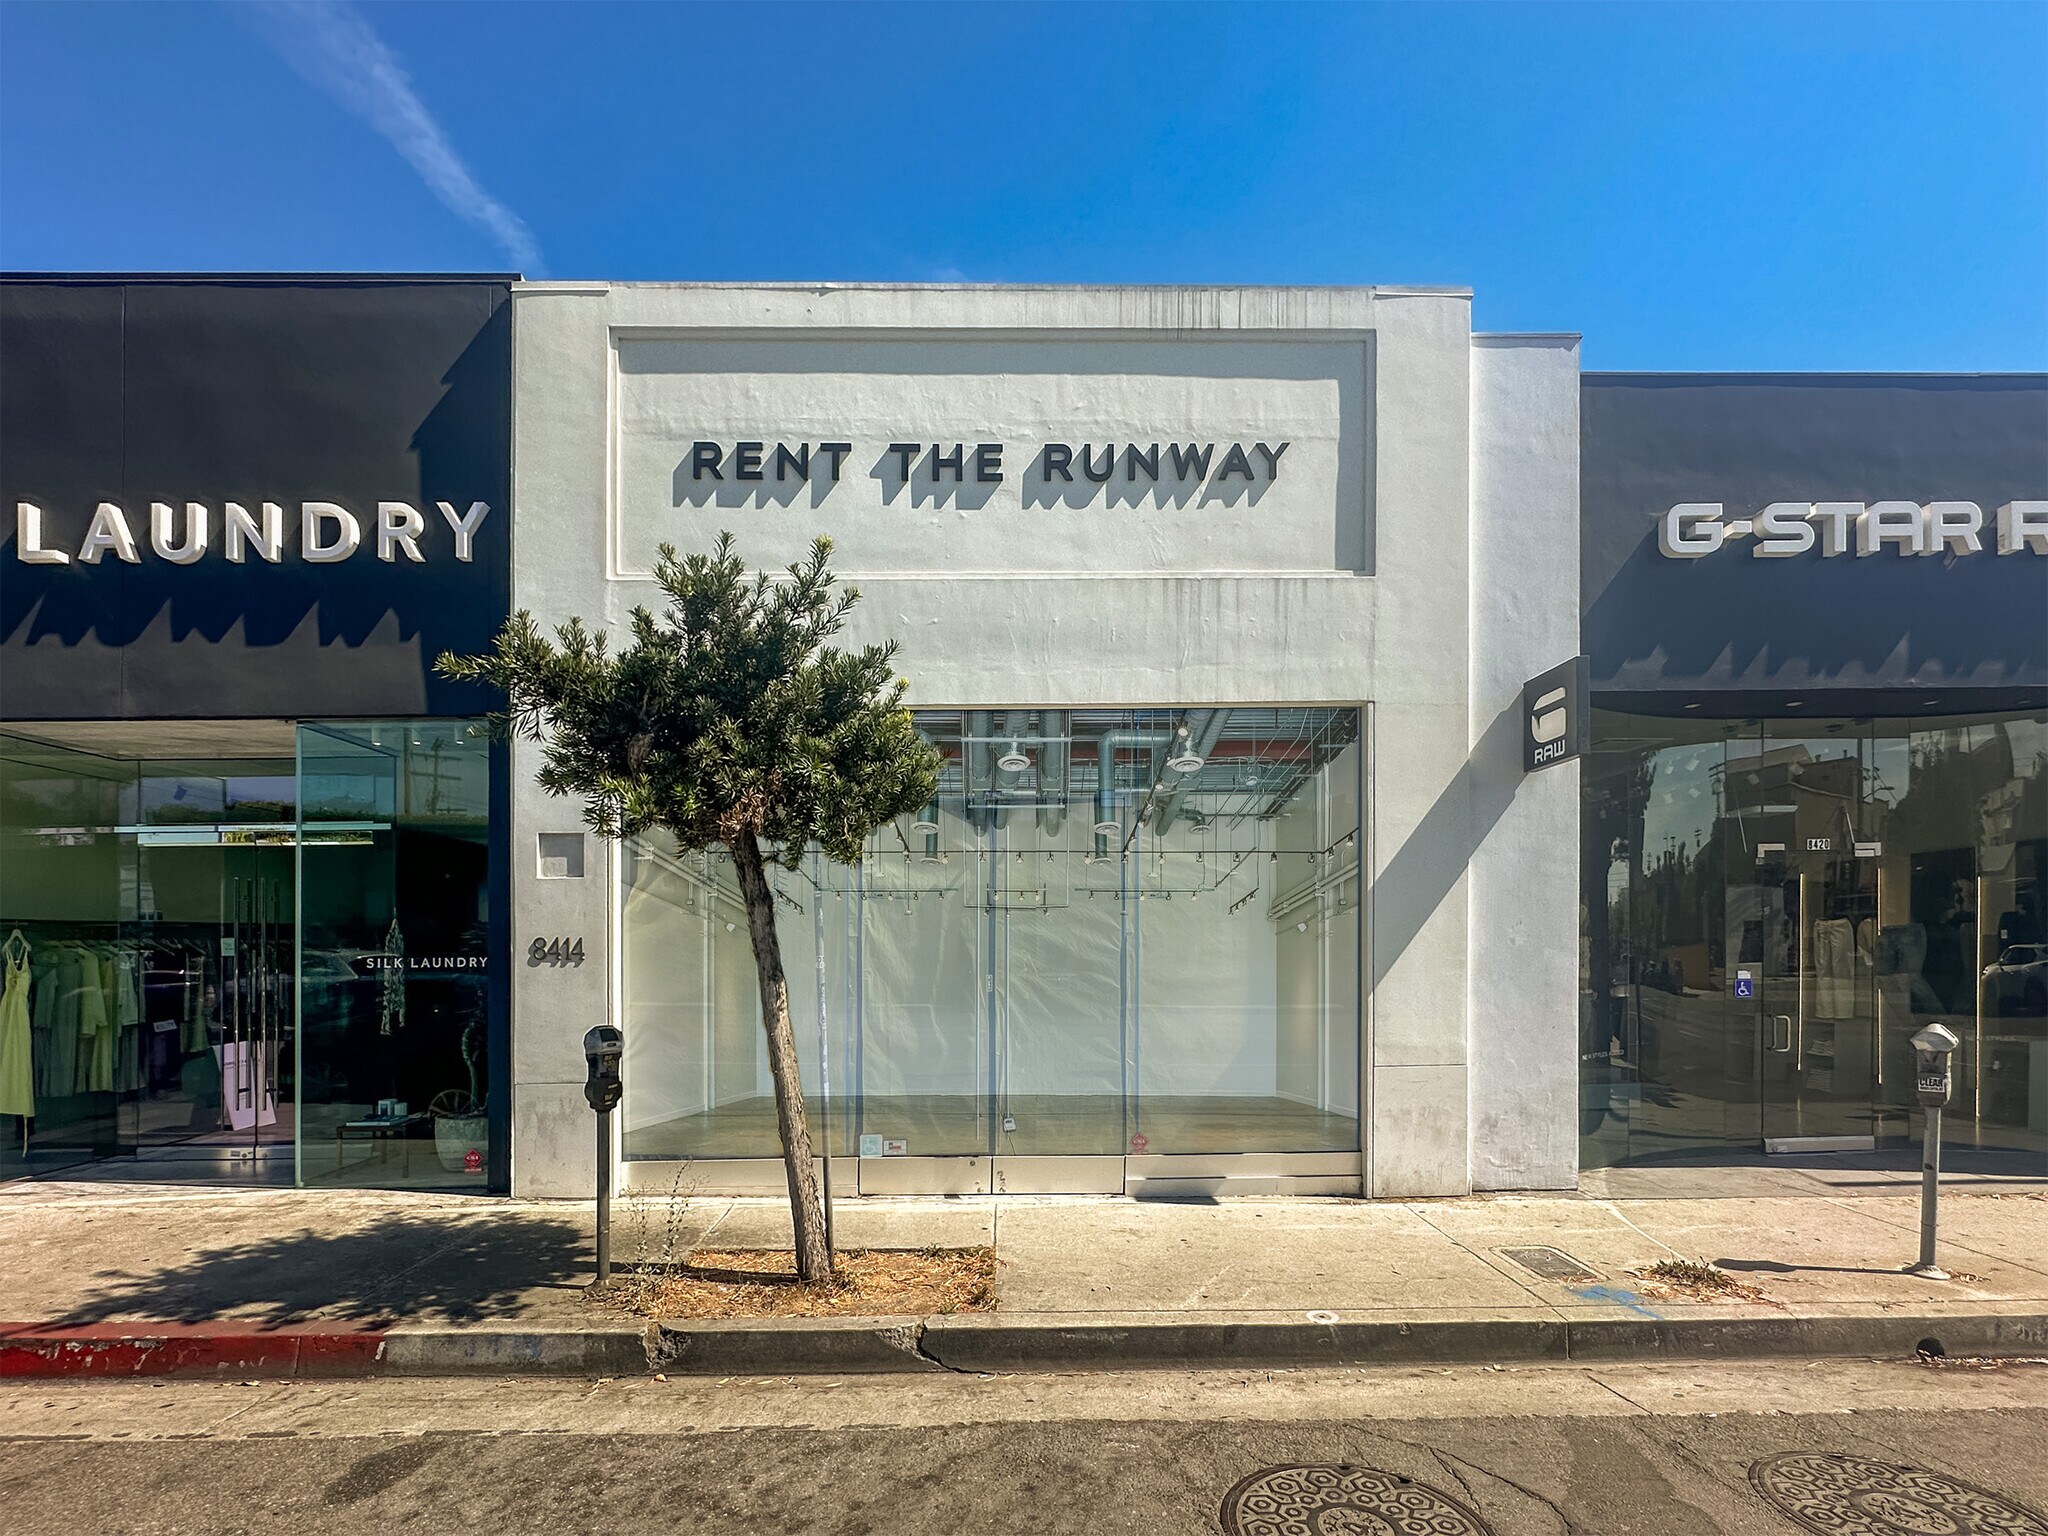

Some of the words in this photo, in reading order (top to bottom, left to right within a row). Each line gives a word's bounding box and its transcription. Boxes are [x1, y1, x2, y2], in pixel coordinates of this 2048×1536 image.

[692, 441, 852, 481] RENT
[890, 442, 1004, 482] THE
[1043, 441, 1290, 482] RUNWAY
[16, 501, 491, 564] LAUNDRY
[1658, 501, 1983, 558] G-STAR
[1534, 739, 1566, 765] RAW
[1808, 839, 1829, 850] 8420
[533, 936, 586, 961] 8414
[366, 958, 403, 969] SILK
[410, 957, 488, 968] LAUNDRY
[1919, 1078, 1944, 1087] CLEAR
